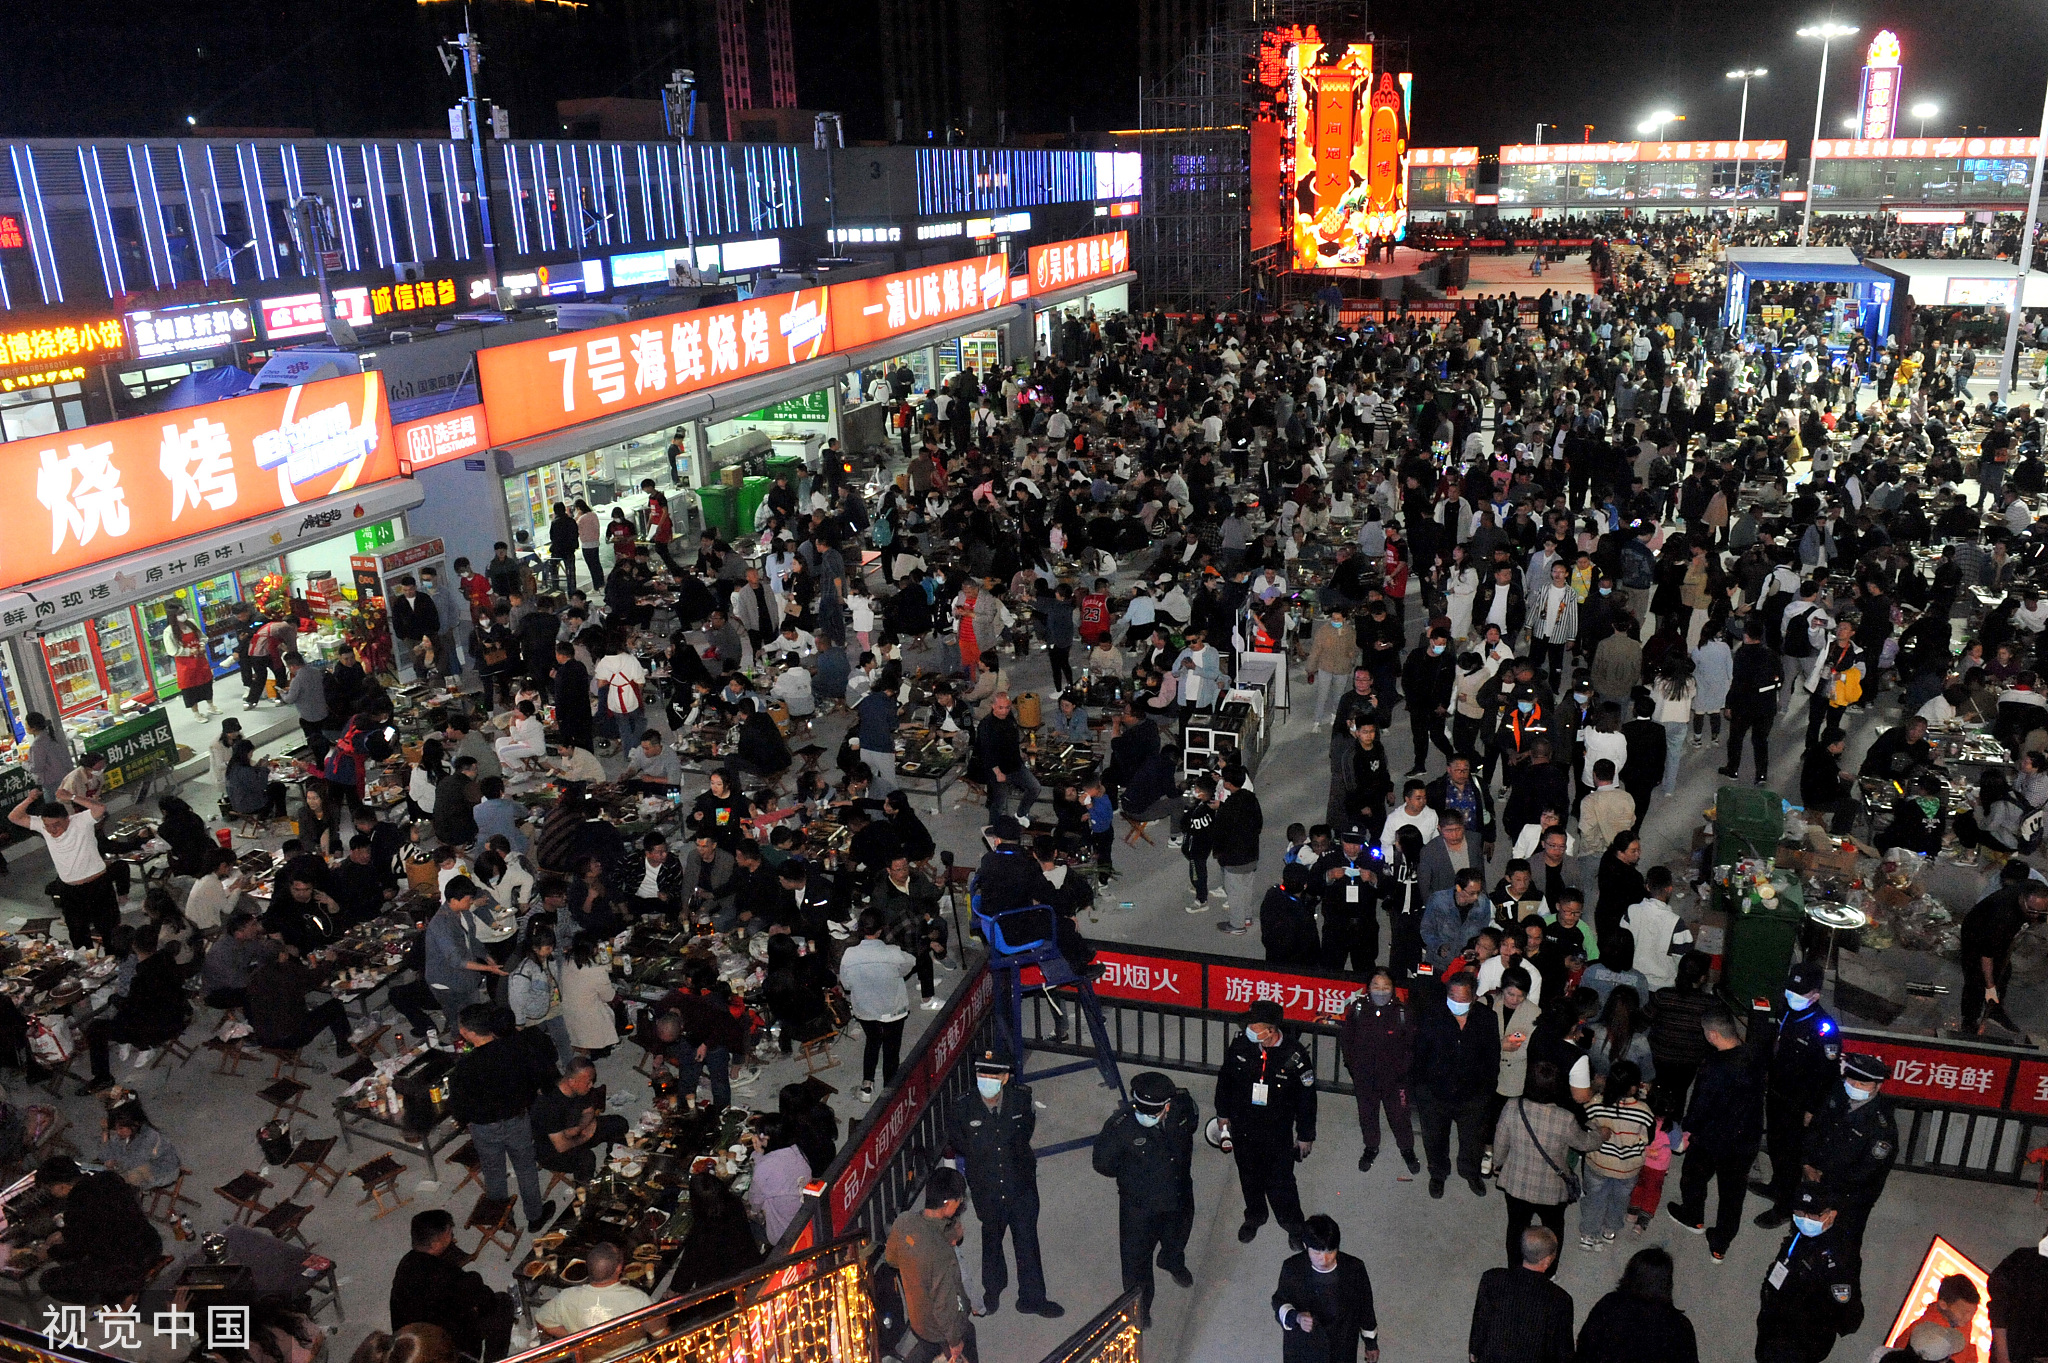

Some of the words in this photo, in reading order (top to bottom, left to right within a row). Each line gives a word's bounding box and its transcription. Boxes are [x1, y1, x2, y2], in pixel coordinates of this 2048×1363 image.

[1325, 97, 1343, 187] 人间烟火
[1376, 128, 1392, 178] 淄博
[870, 161, 881, 179] 3
[1049, 239, 1100, 285] 吴氏烧烤
[370, 278, 457, 316] 诚信海参
[548, 307, 769, 412] 7号海鲜烧烤
[434, 415, 476, 444] 洗手间
[437, 436, 477, 456] RESTROOM
[37, 417, 238, 554] 烧烤
[3, 583, 110, 627] 鲜肉现烤
[1083, 607, 1101, 623] 23
[1095, 960, 1181, 995] 间烟火
[1893, 1059, 1994, 1094] 吃海鲜
[843, 1085, 918, 1212] 品人间烟火
